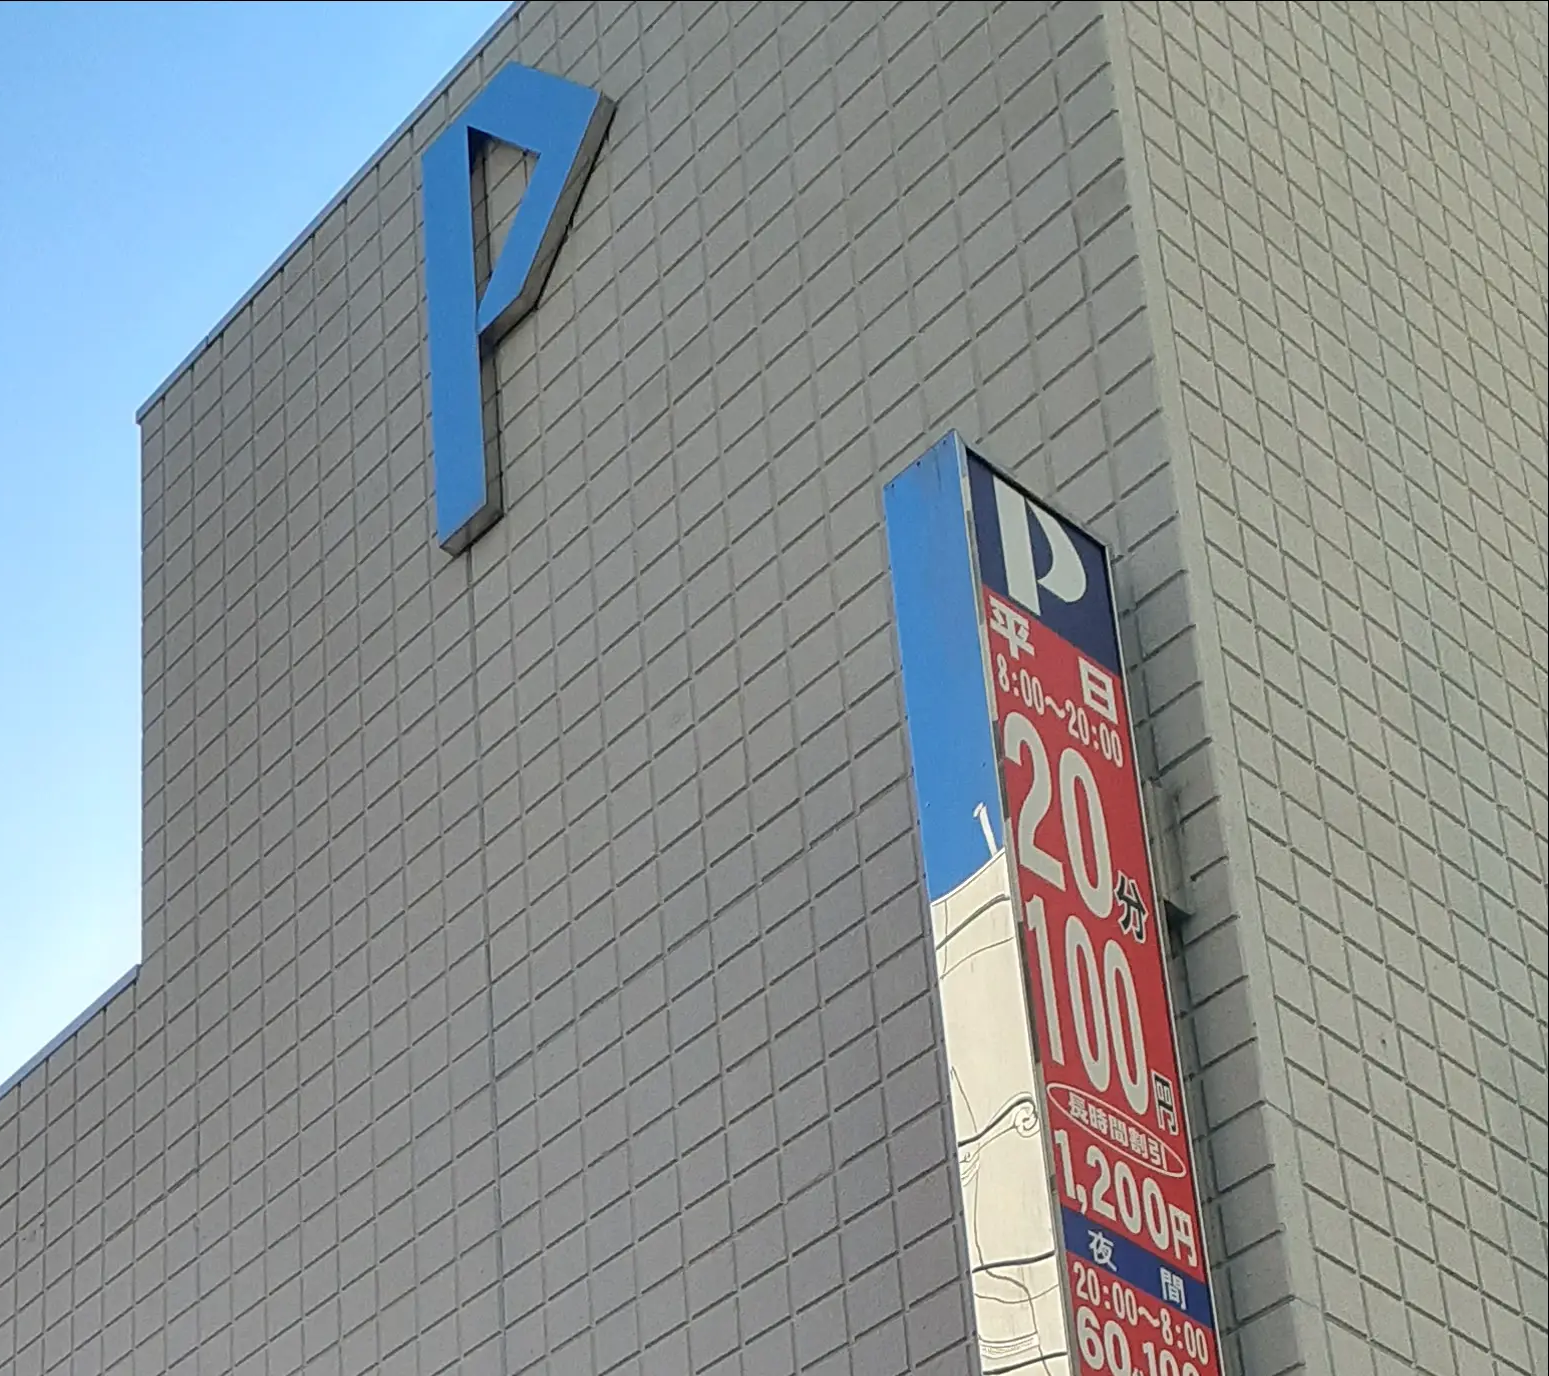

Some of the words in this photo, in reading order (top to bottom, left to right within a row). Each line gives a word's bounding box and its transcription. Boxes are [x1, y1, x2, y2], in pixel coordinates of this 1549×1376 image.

[421, 60, 617, 556] P
[993, 476, 1086, 616] P
[988, 595, 1118, 725] 平日
[1054, 1129, 1197, 1267] 1,200円
[1068, 1091, 1168, 1171] 長時間割引
[1088, 1230, 1186, 1310] 夜間
